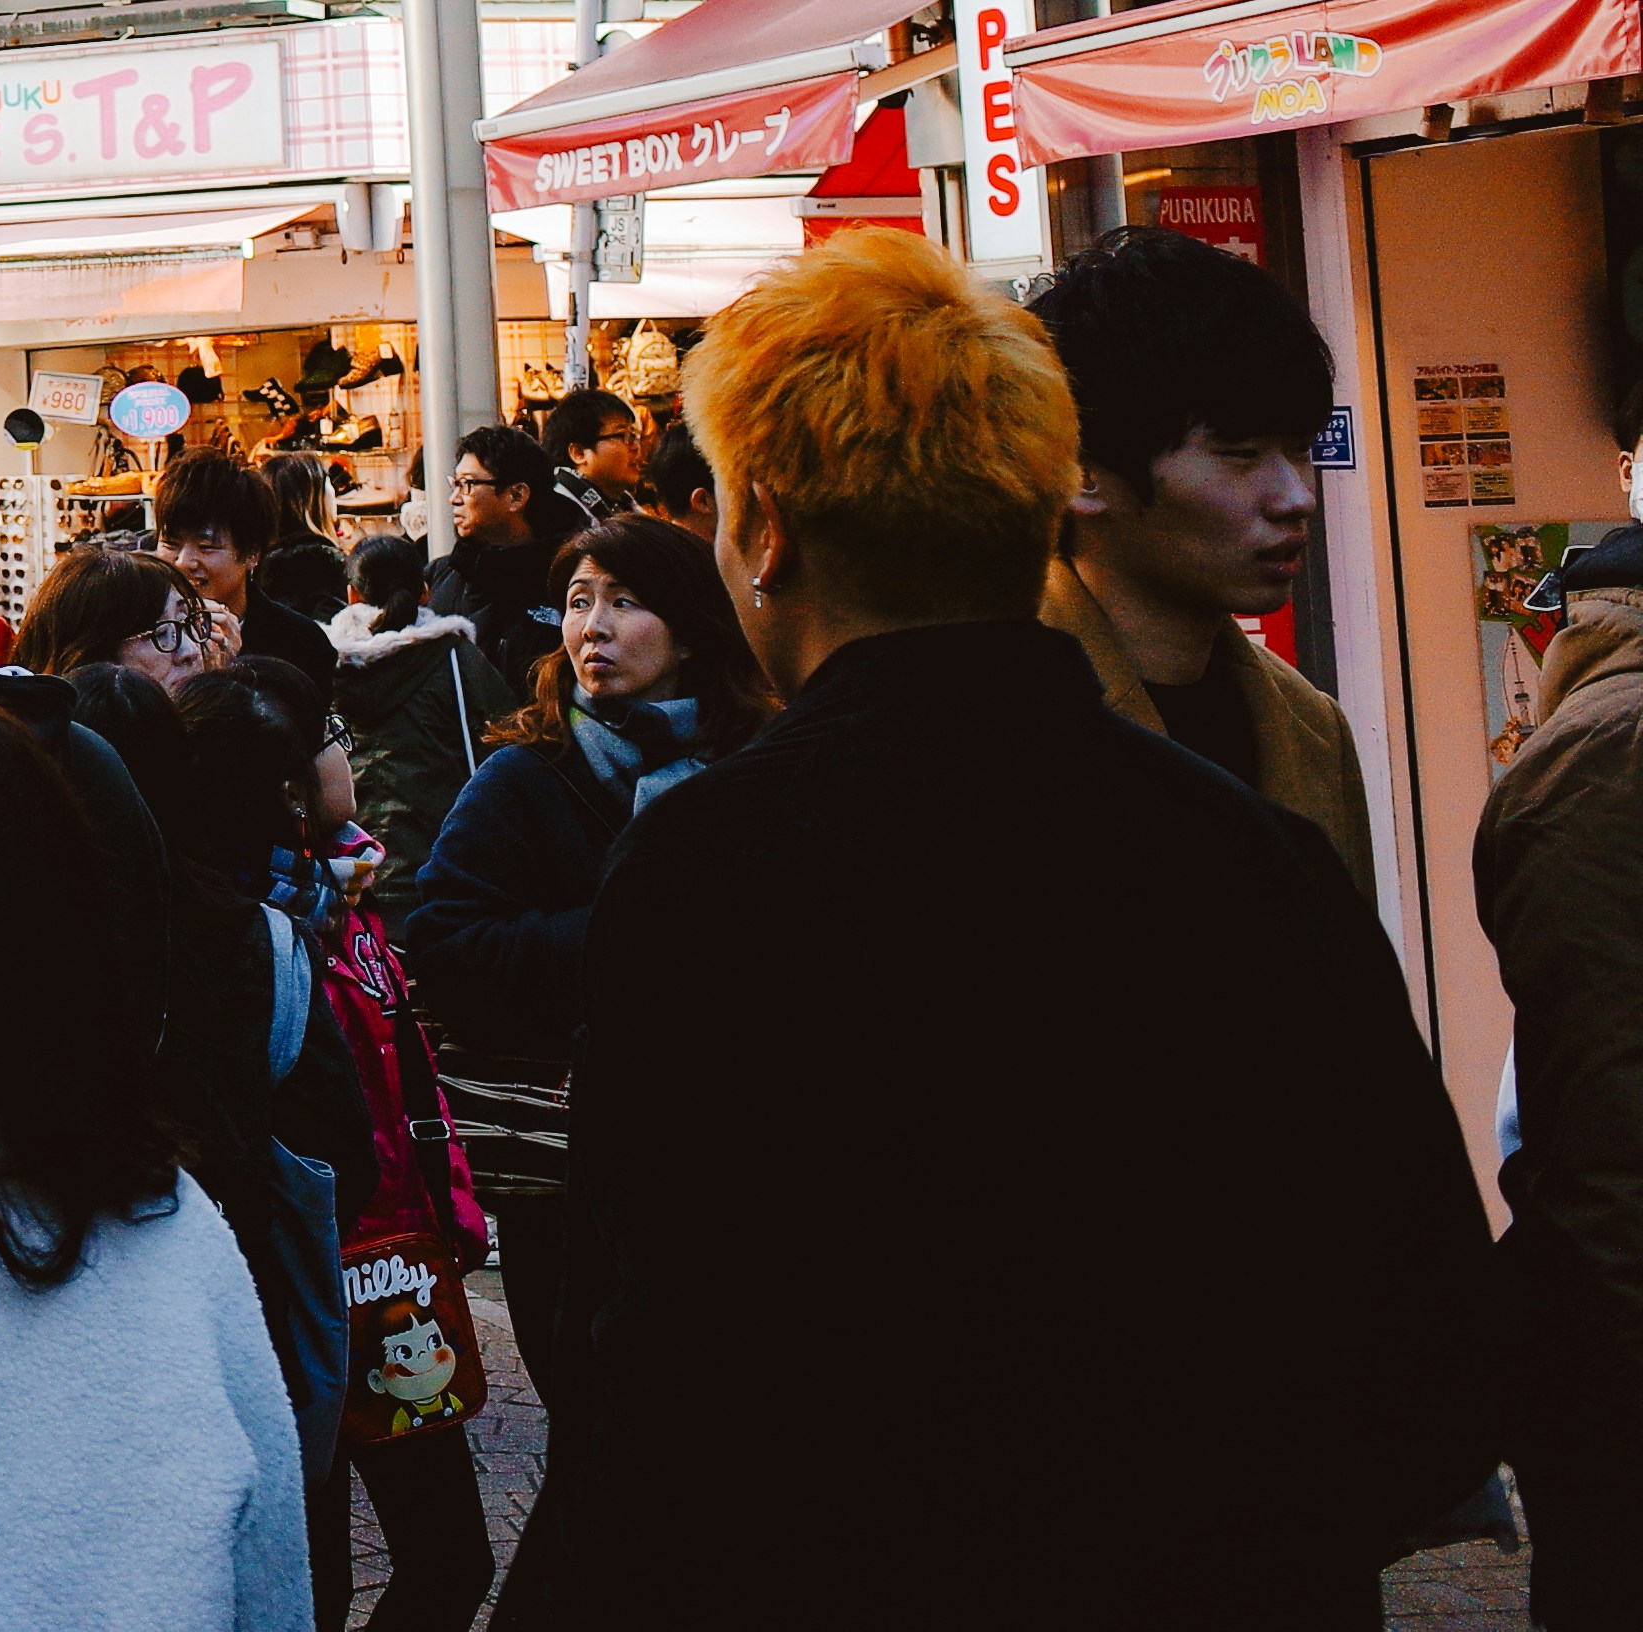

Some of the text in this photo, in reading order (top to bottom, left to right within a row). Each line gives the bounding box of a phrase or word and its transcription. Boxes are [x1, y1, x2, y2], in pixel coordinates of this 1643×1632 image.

[1203, 29, 1383, 102] プリクラ LAND
[1251, 76, 1327, 125] NOA
[534, 106, 792, 194] SWEET BOX クレープ
[1161, 195, 1256, 225] PURIKURA
